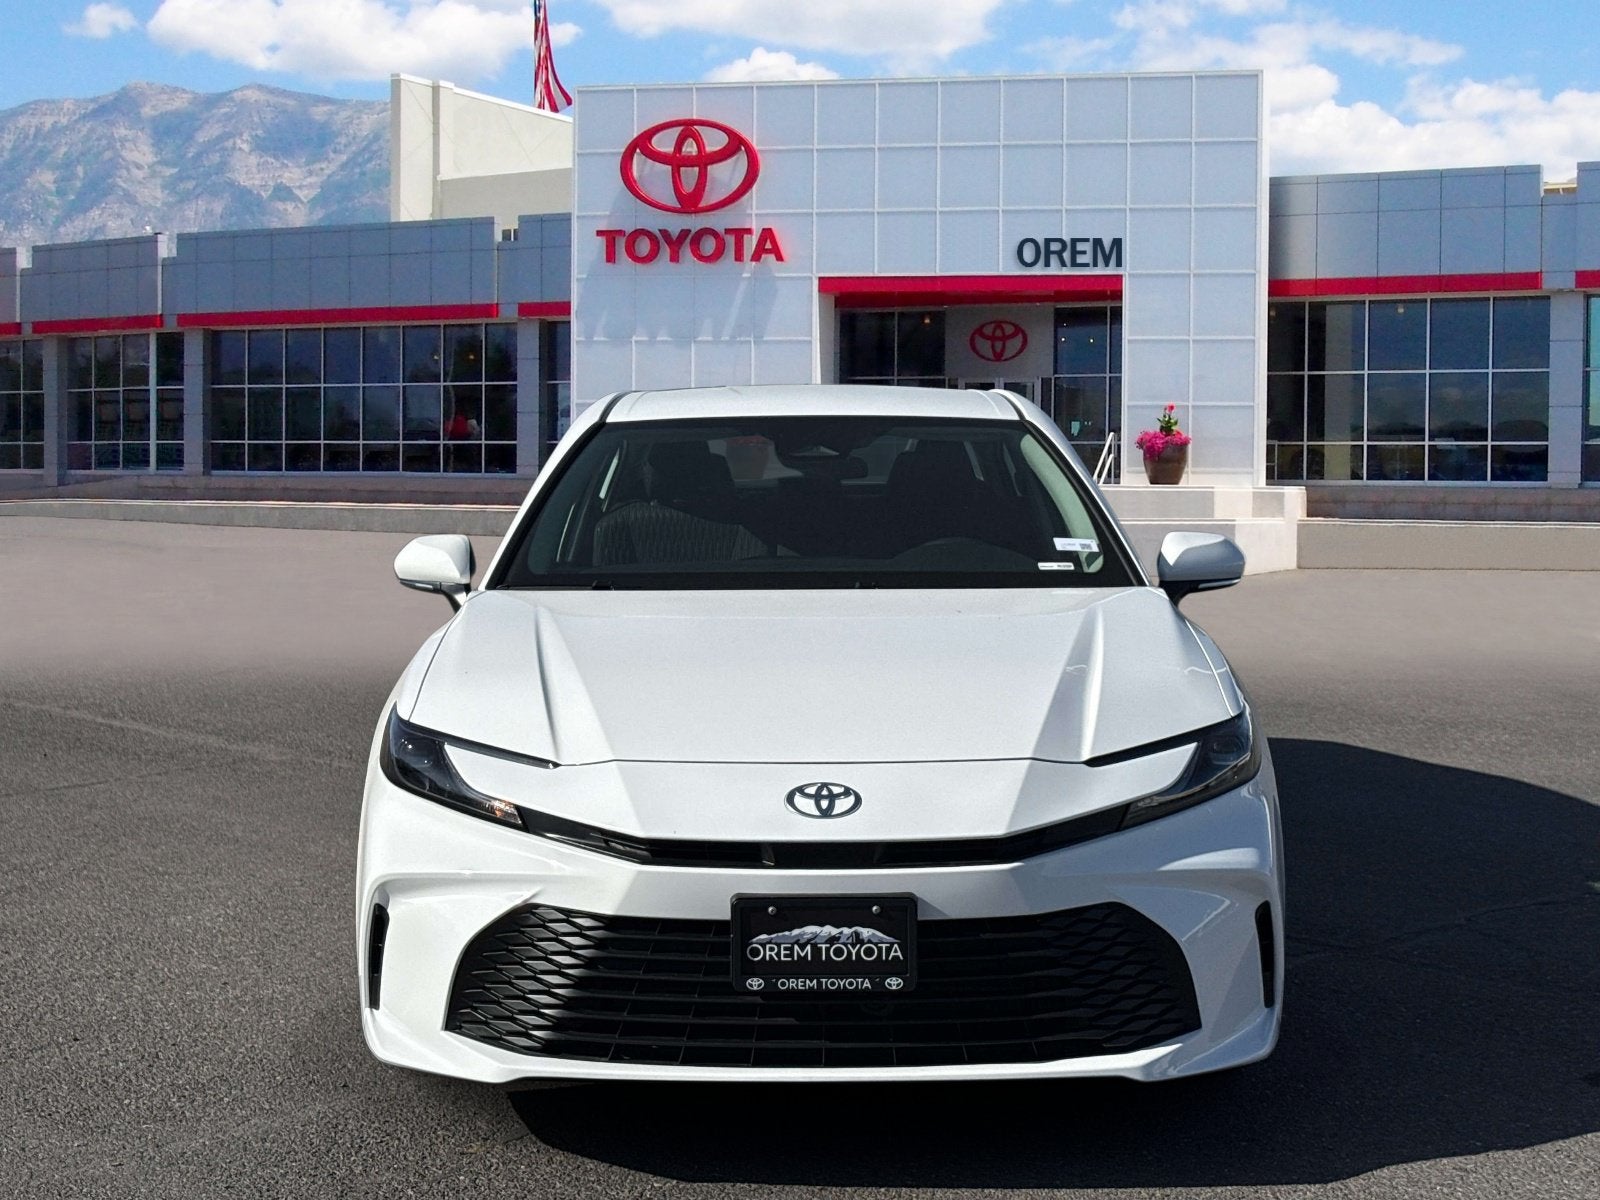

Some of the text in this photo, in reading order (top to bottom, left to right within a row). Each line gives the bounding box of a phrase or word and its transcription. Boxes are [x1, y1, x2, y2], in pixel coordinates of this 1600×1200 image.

[596, 227, 784, 264] TOYOTA
[1017, 237, 1122, 267] OREM
[746, 943, 903, 961] OREM TOYOTA
[777, 978, 871, 990] OREM TOYOTA
